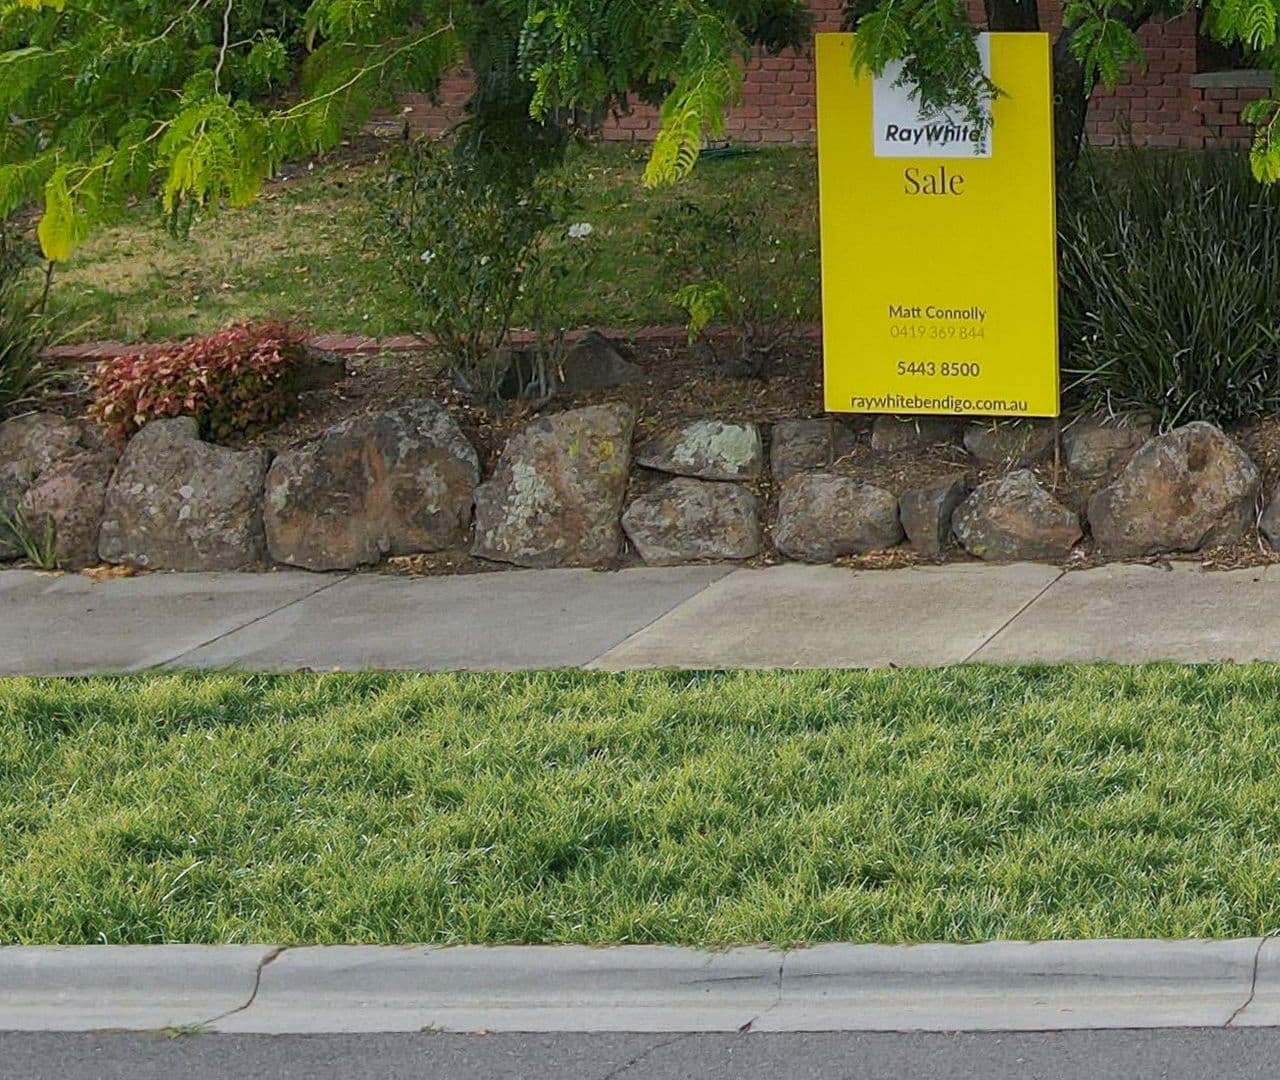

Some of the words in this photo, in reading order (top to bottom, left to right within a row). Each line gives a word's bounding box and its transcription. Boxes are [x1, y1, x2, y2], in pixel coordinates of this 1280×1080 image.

[904, 165, 965, 196] Sale
[889, 305, 921, 319] Matt
[925, 306, 987, 322] Connolly
[890, 325, 926, 339] 0419
[931, 327, 955, 340] 369
[959, 329, 985, 340] 844
[897, 361, 936, 376] 5443
[940, 362, 980, 377] 8500
[850, 394, 1028, 412] raywhitebendigo.com.au
